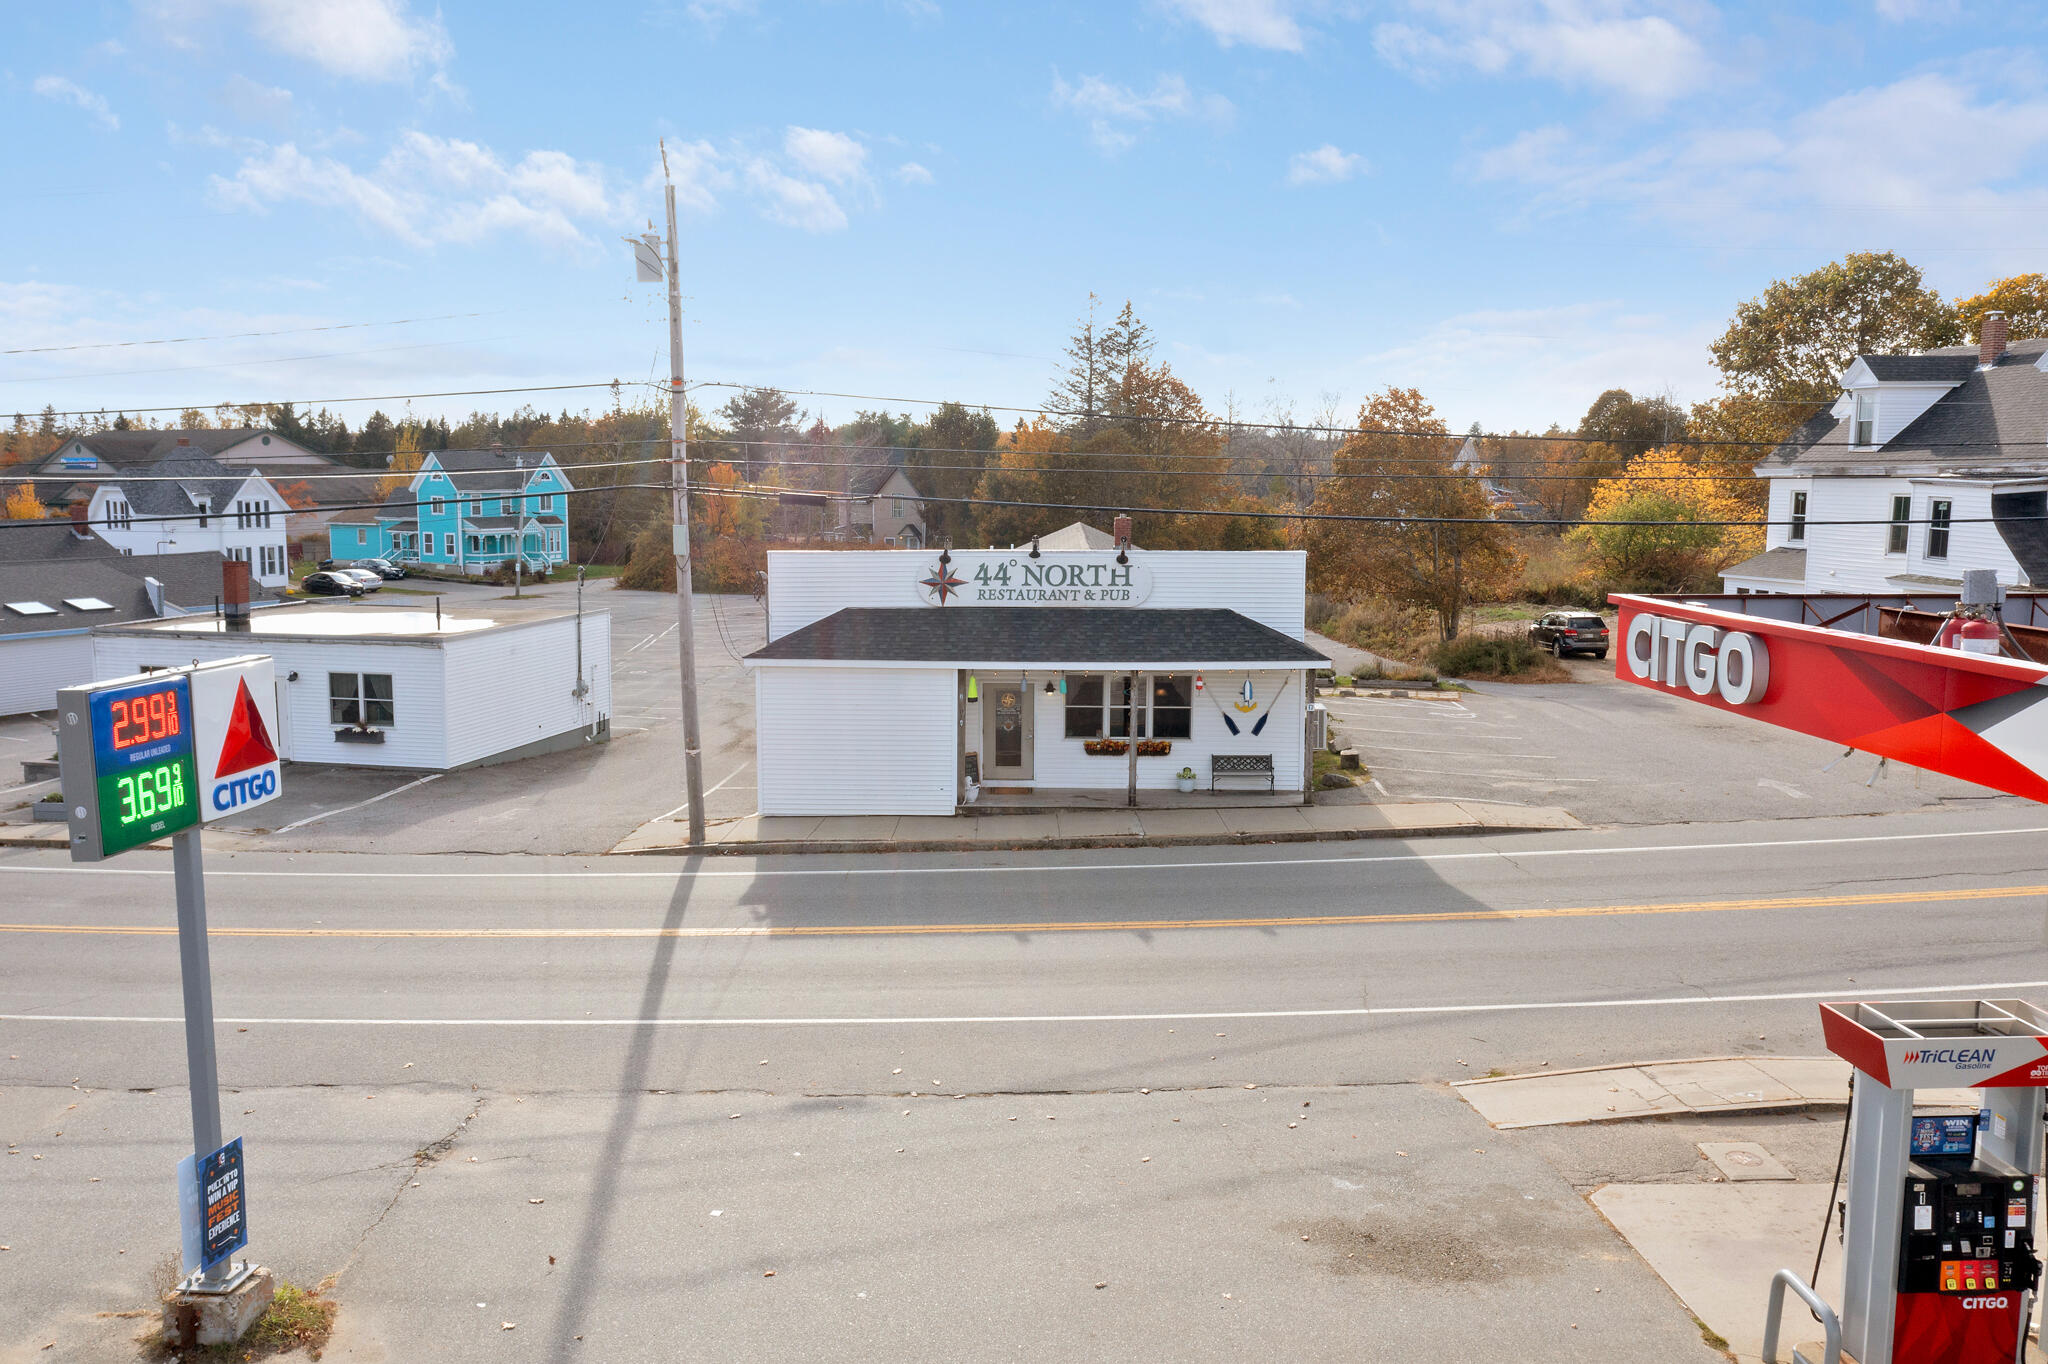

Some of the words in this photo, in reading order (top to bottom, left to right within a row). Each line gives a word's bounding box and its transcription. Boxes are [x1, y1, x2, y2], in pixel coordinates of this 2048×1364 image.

[974, 559, 1017, 586] 44°
[1021, 564, 1134, 587] NORTH
[977, 588, 1081, 601] RESTAURANT
[1084, 589, 1096, 601] &
[1100, 589, 1130, 601] PUB
[1626, 612, 1762, 706] CITGO
[111, 693, 166, 750] 2.99
[129, 749, 151, 762] REGULAR
[150, 744, 171, 758] UNLEADED
[118, 766, 172, 824] 3.69
[212, 769, 276, 812] CITGO
[150, 820, 166, 832] DIESEL
[1920, 1049, 1996, 1064] TriCLEAN
[1955, 1062, 1992, 1070] Gasoline
[1945, 1119, 1969, 1127] WIN
[207, 1176, 223, 1195] PULL
[223, 1172, 230, 1185] IN
[230, 1168, 238, 1180] TO
[208, 1187, 222, 1206] WIN
[222, 1185, 228, 1198] A
[227, 1179, 239, 1193] VIP
[208, 1189, 239, 1217] MUSIC
[208, 1200, 240, 1228] FEST
[208, 1210, 241, 1241] EXPERIENCE
[1963, 1296, 2008, 1309] CITGO
